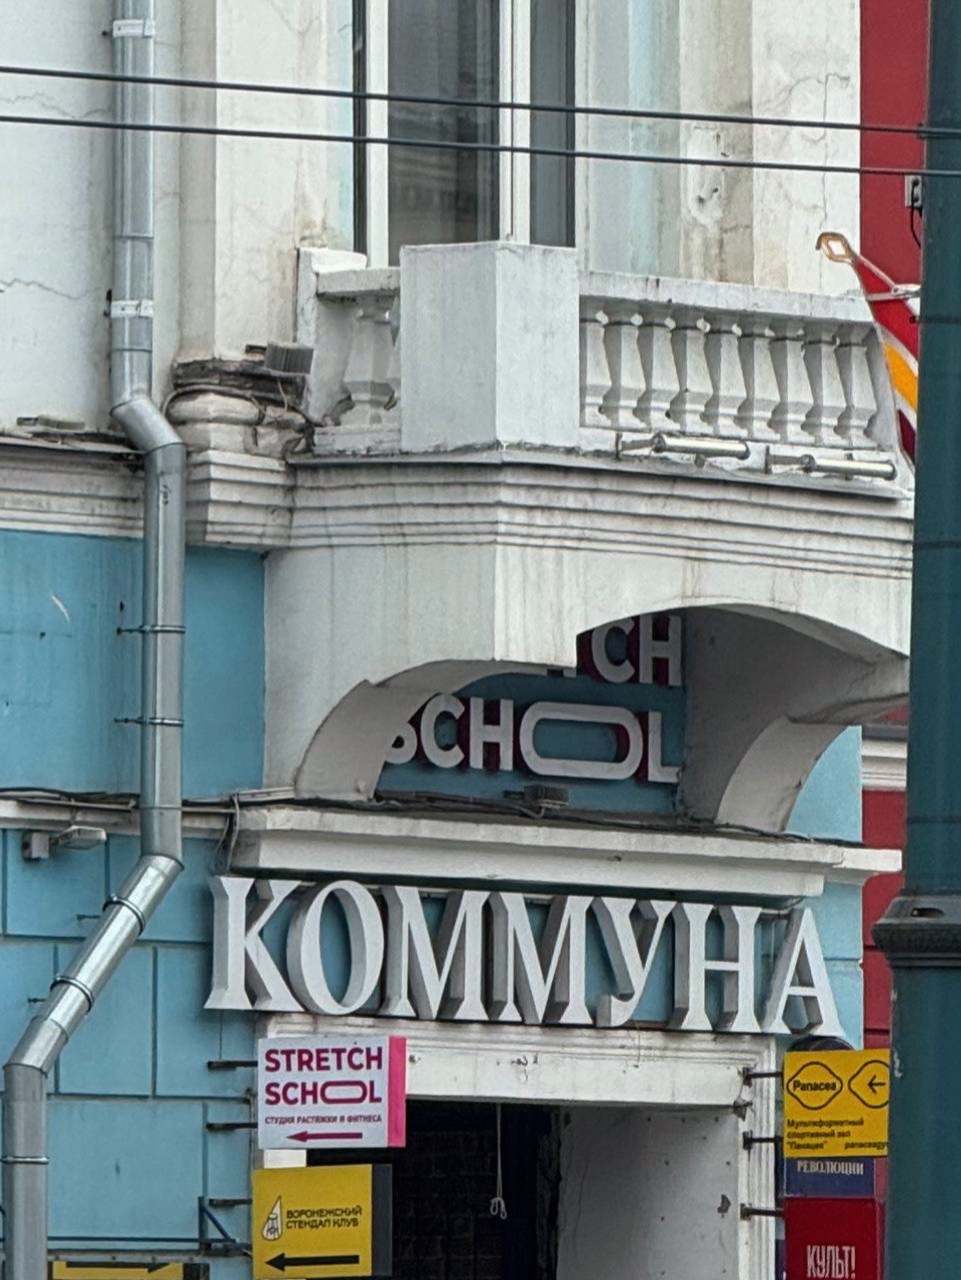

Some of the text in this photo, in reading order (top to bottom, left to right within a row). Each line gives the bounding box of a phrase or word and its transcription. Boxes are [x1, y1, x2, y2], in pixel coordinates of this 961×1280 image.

[204, 876, 844, 1036] КОММУНА
[264, 1047, 383, 1072] STRETCH
[793, 1080, 837, 1091] Panacea
[265, 1116, 295, 1125] СТУДИЯ
[347, 1114, 382, 1123] ФИТНЕСА
[797, 1160, 864, 1175] РЕВОЛЮЦИИ
[287, 1205, 362, 1219] ВОРОНЕЖСКИЙ
[333, 1218, 359, 1228] КЛУБ
[806, 1245, 856, 1280] КУЛЬТ!
